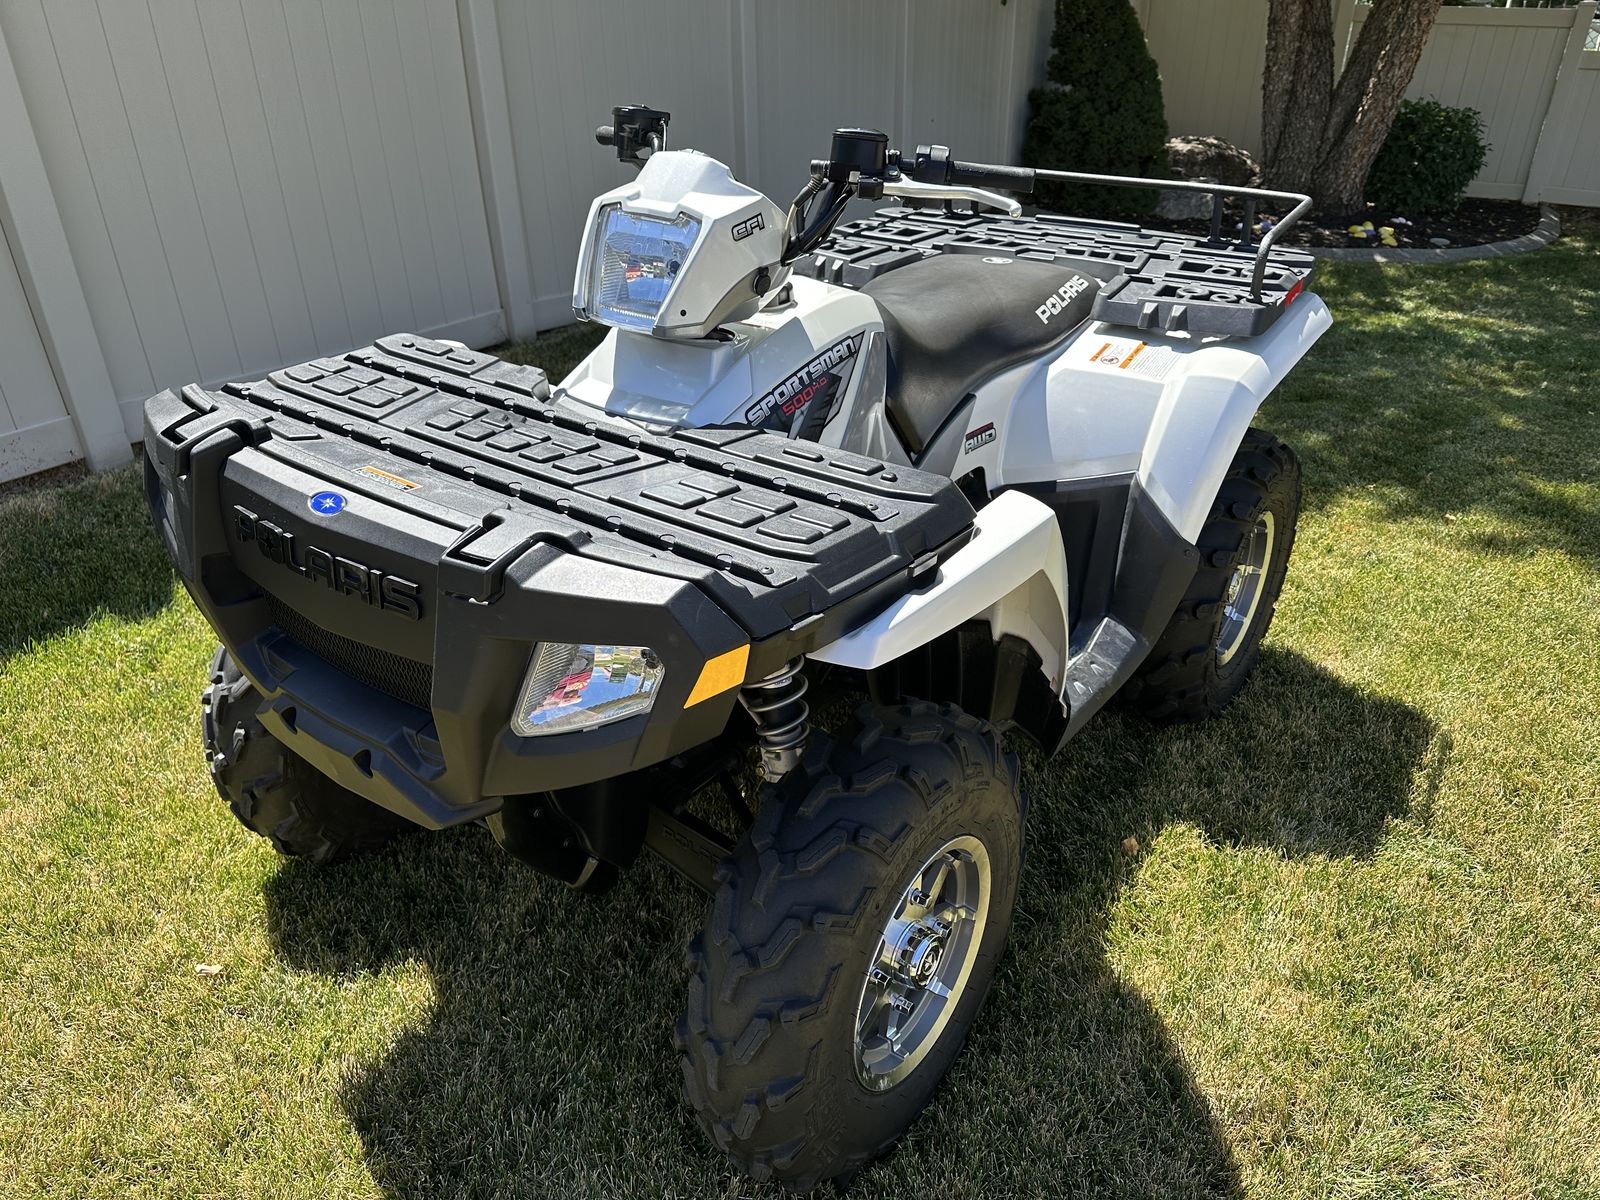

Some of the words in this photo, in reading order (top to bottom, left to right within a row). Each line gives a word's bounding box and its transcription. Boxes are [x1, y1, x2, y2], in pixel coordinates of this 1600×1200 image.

[732, 213, 765, 242] EFI
[1035, 274, 1089, 325] POLARIS
[746, 338, 856, 427] SPORTSMAN
[782, 388, 815, 416] 500
[964, 428, 997, 455] AWD
[233, 504, 422, 621] POLARIS
